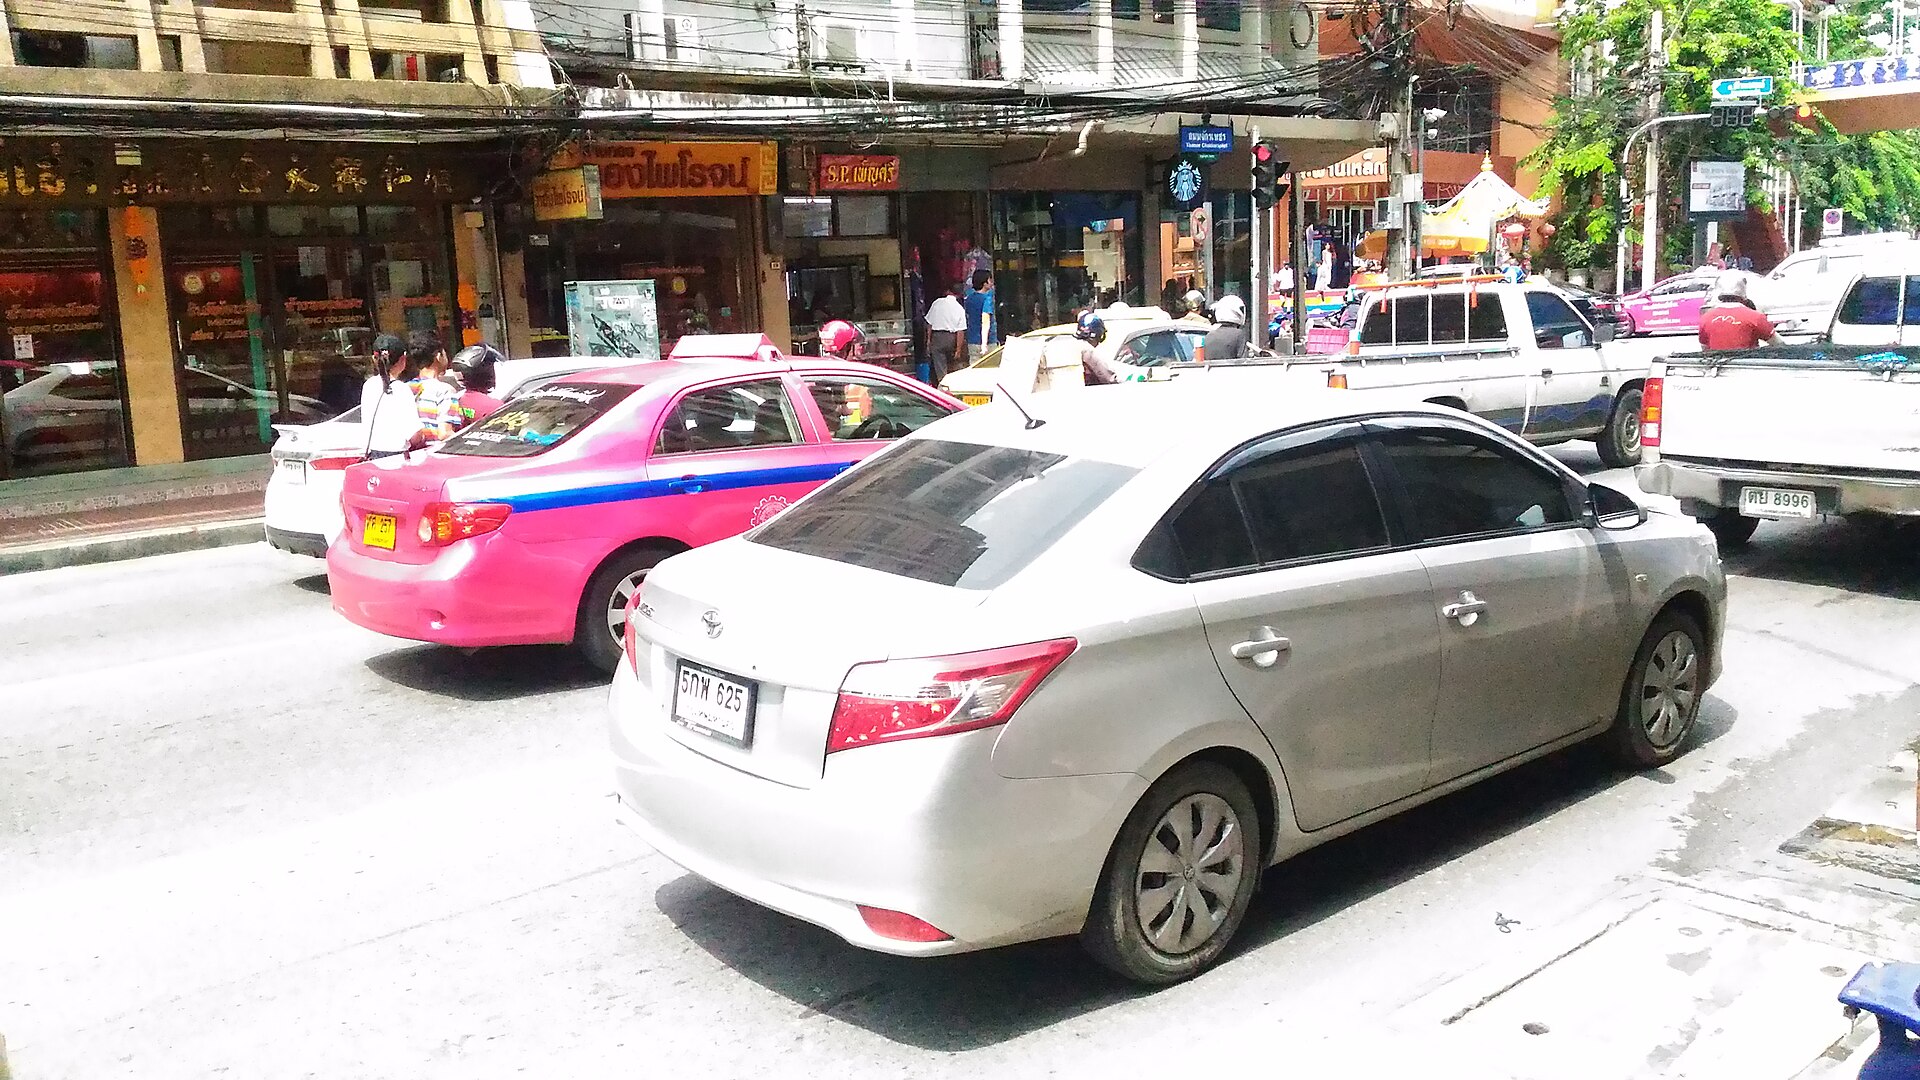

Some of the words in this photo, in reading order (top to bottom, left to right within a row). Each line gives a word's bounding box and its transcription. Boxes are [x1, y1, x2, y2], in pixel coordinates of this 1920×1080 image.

[601, 149, 750, 189] องไพโรจน์
[828, 165, 849, 183] S.P.
[1773, 493, 1809, 508] 8996
[716, 682, 743, 712] 625
